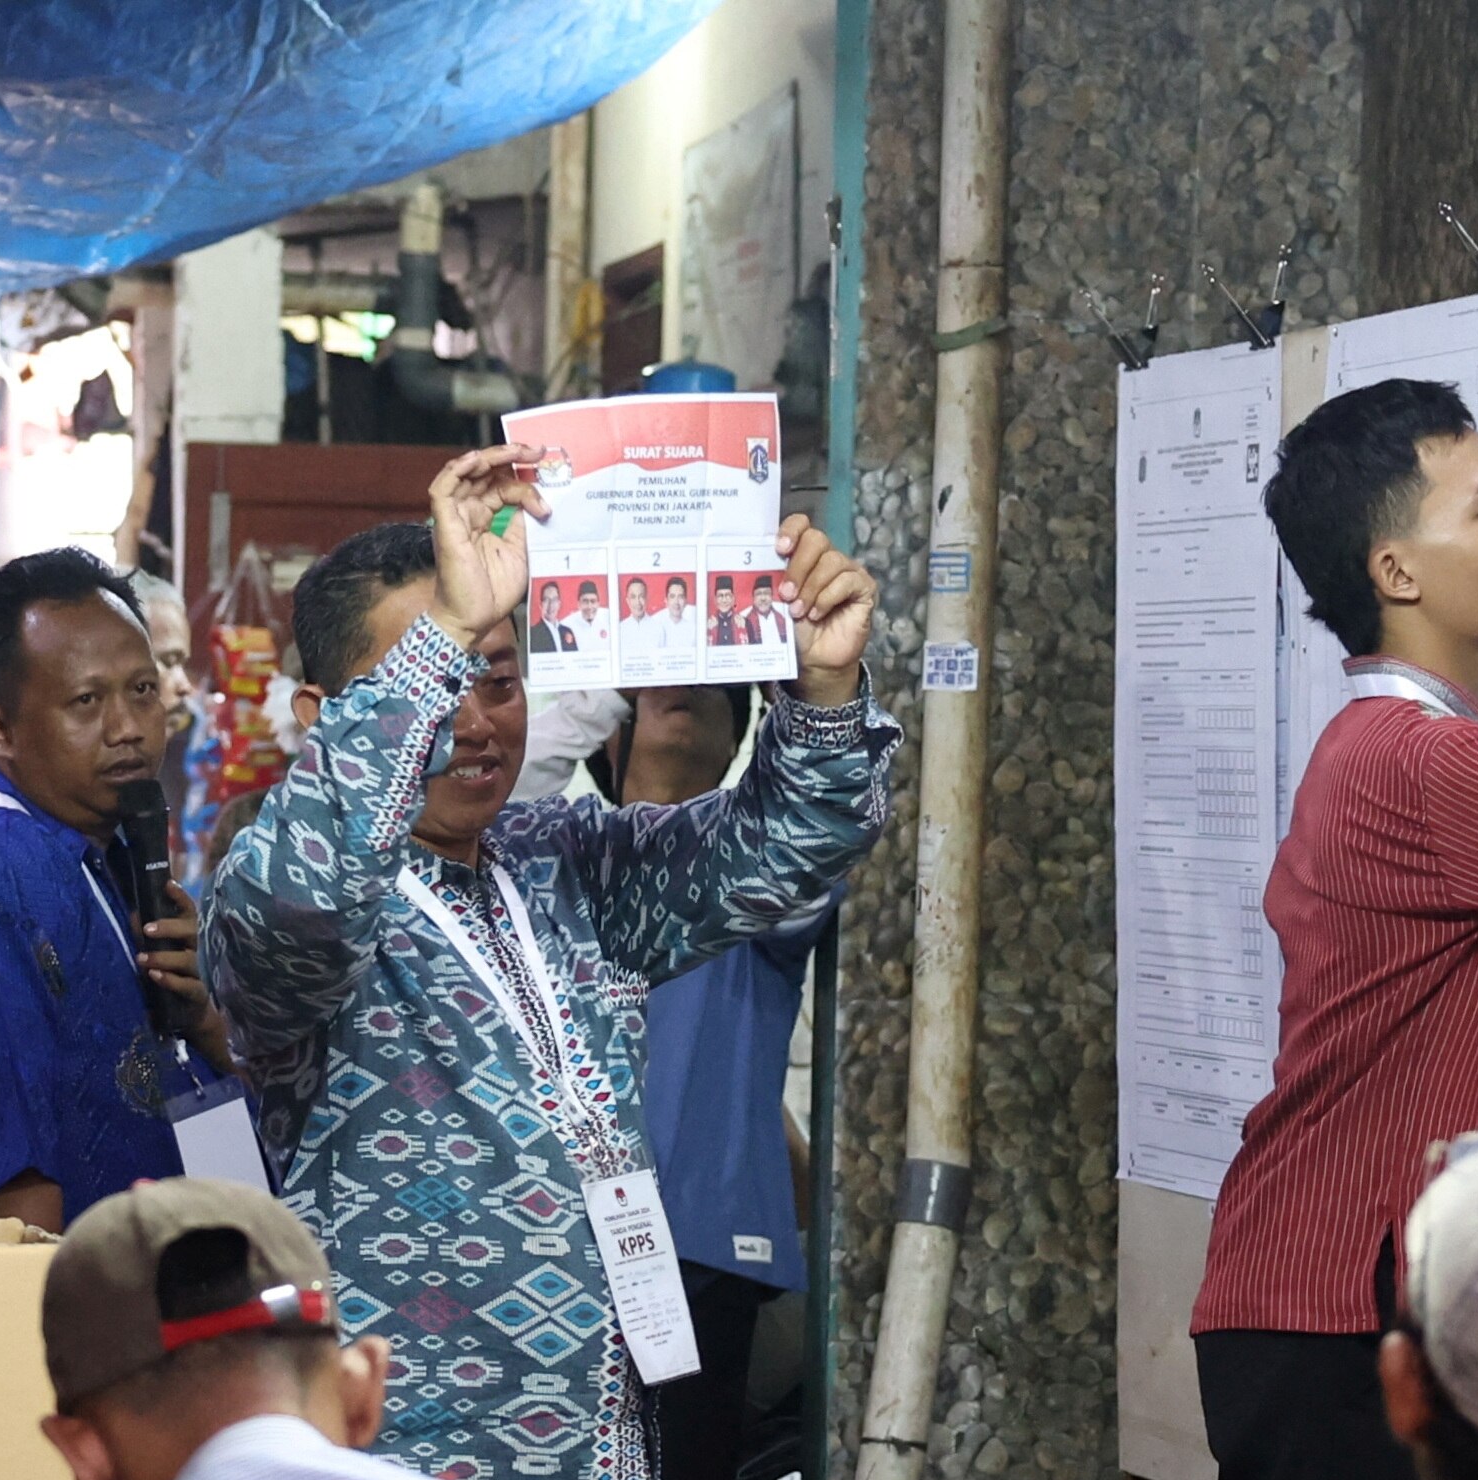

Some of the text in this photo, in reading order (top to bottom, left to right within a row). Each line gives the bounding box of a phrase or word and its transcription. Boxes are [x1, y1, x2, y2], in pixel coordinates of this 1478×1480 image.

[624, 445, 704, 459] SURAT SUARA
[638, 476, 687, 486] PEMILIHAN
[586, 488, 739, 500] GUBERNUR DAN WAKIL GUBERNUR
[607, 501, 712, 512] PROVINSI DKI JAKARTA
[632, 515, 686, 525] TAHUN 2024
[564, 554, 571, 569] 1
[652, 552, 661, 567] 2
[743, 551, 752, 565] 3
[618, 1232, 655, 1257] KPPS
